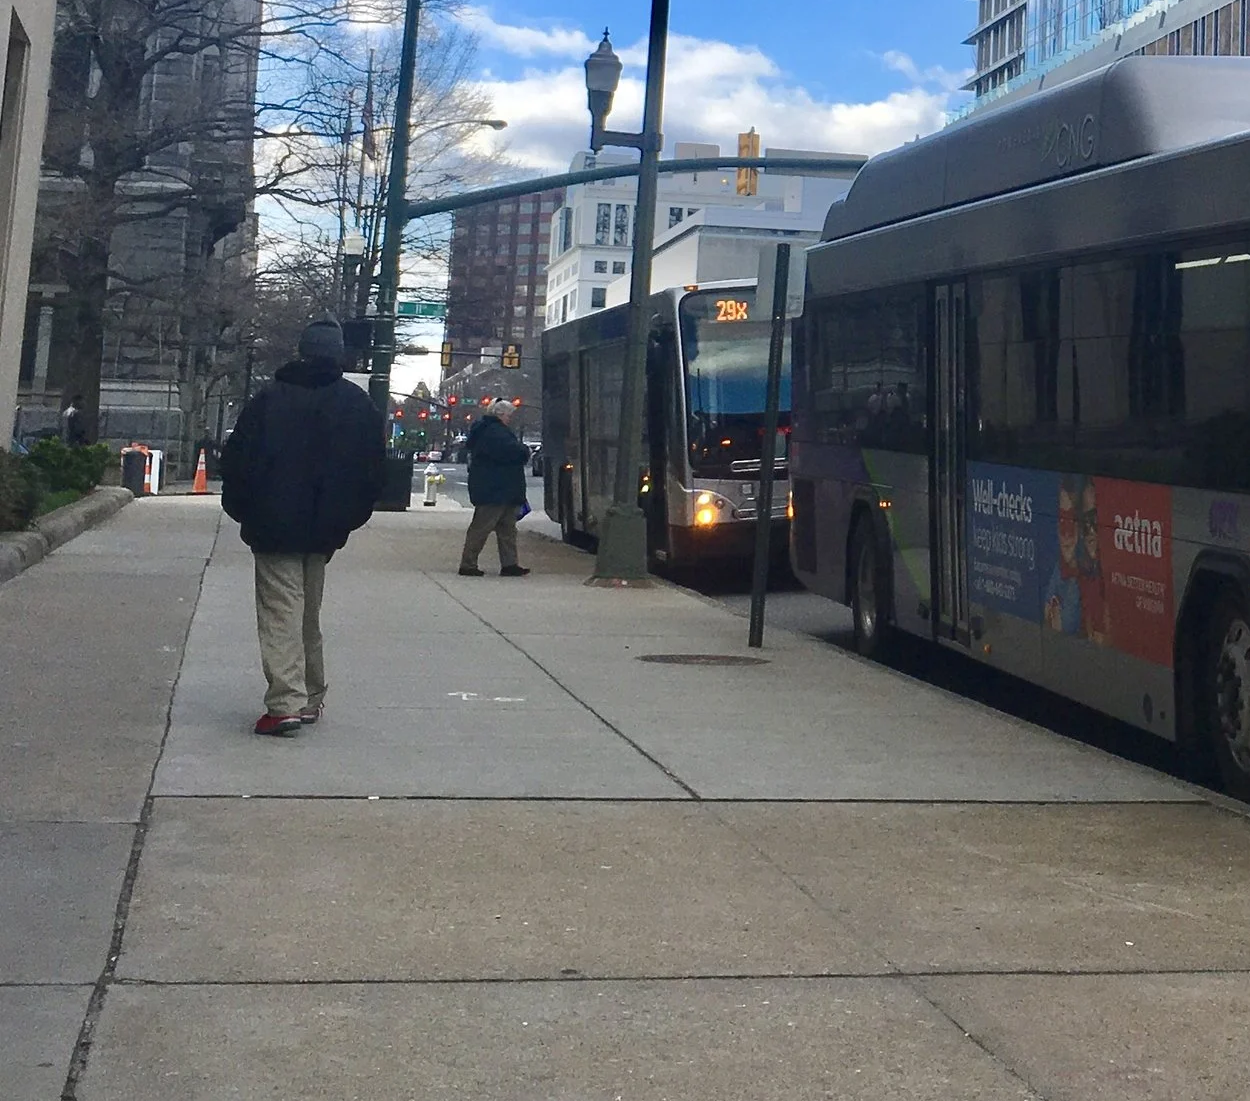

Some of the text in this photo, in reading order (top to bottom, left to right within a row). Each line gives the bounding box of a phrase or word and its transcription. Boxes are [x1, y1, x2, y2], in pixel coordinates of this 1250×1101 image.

[1056, 113, 1095, 167] CNG
[972, 478, 1033, 524] Well-checks
[1114, 509, 1163, 558] aetna
